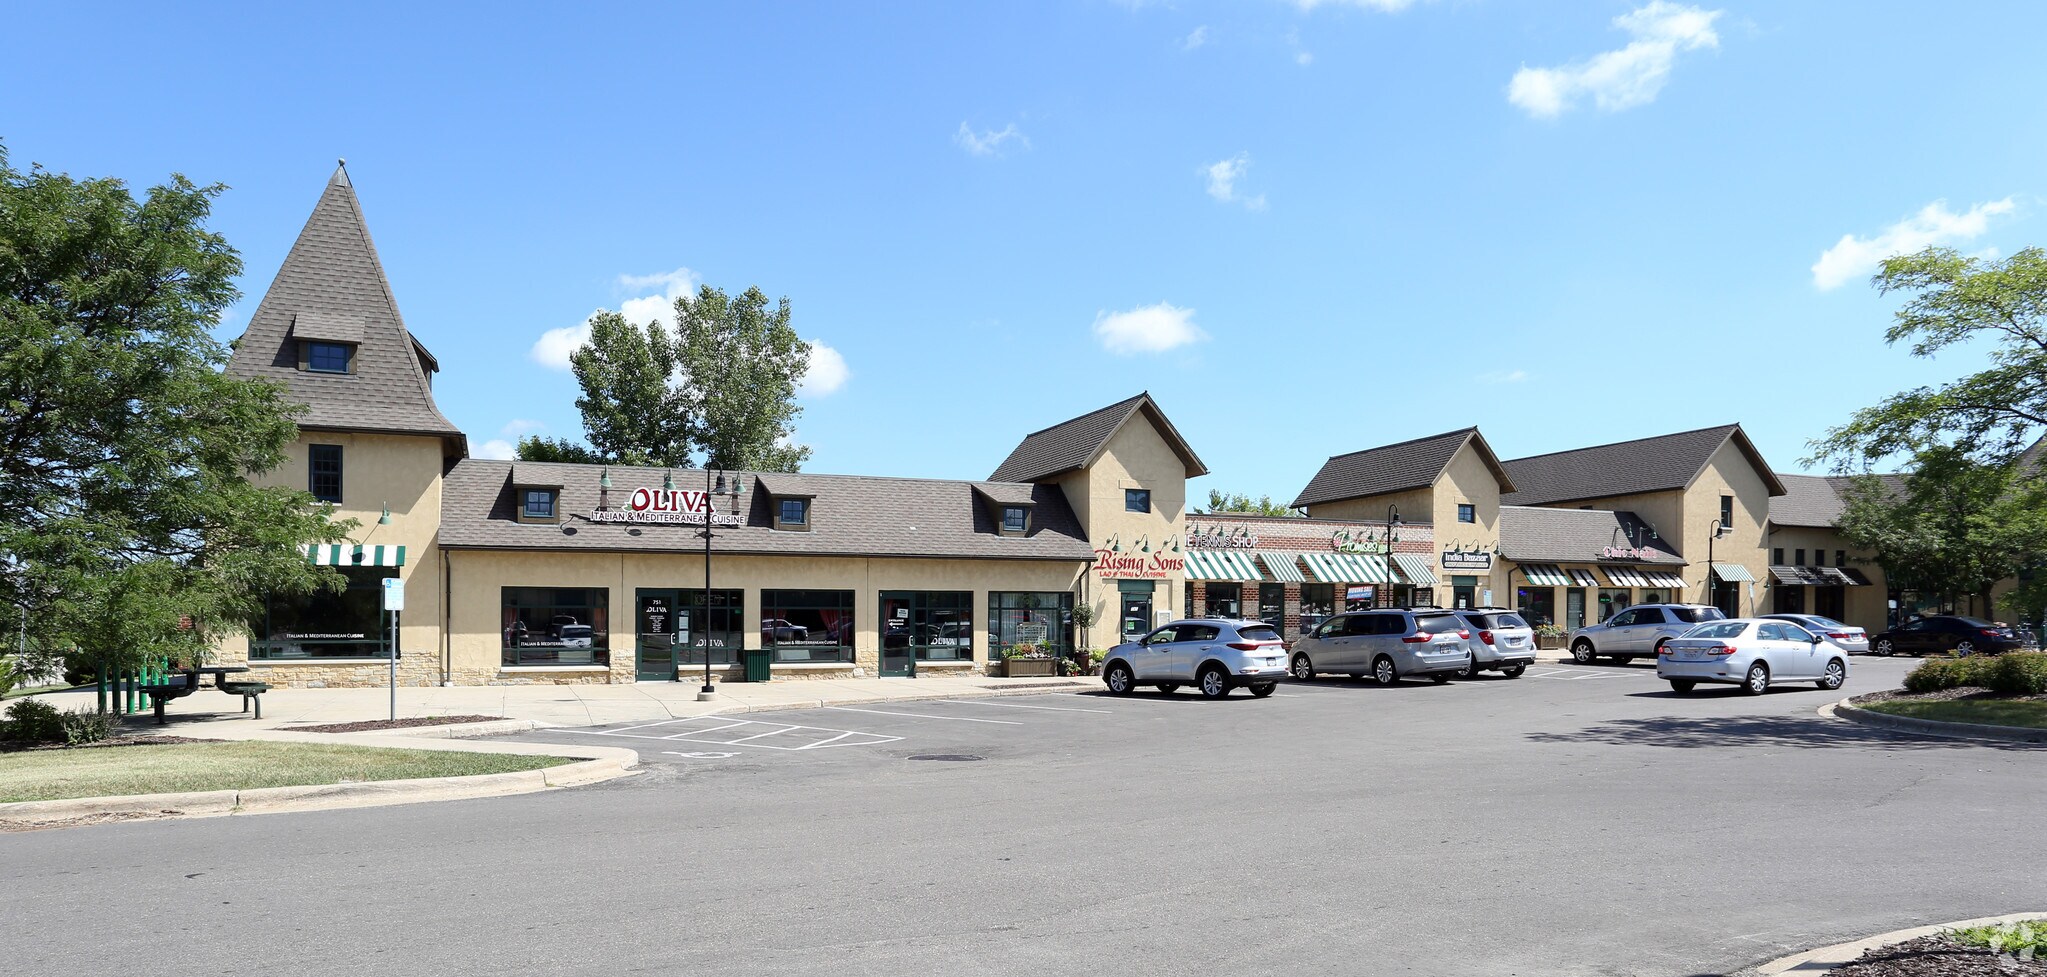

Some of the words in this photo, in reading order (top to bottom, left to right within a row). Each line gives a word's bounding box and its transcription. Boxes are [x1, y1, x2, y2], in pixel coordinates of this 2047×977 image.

[631, 488, 714, 513] OLIVA
[591, 511, 625, 520] ITALIAN
[627, 512, 634, 521] &
[711, 514, 744, 524] CUISINE
[1232, 536, 1258, 548] SHOP
[1334, 532, 1378, 552] Promises
[1092, 550, 1145, 577] Rising
[1148, 551, 1184, 570] Sons
[1445, 552, 1462, 561] India
[1464, 554, 1488, 562] Bazaar
